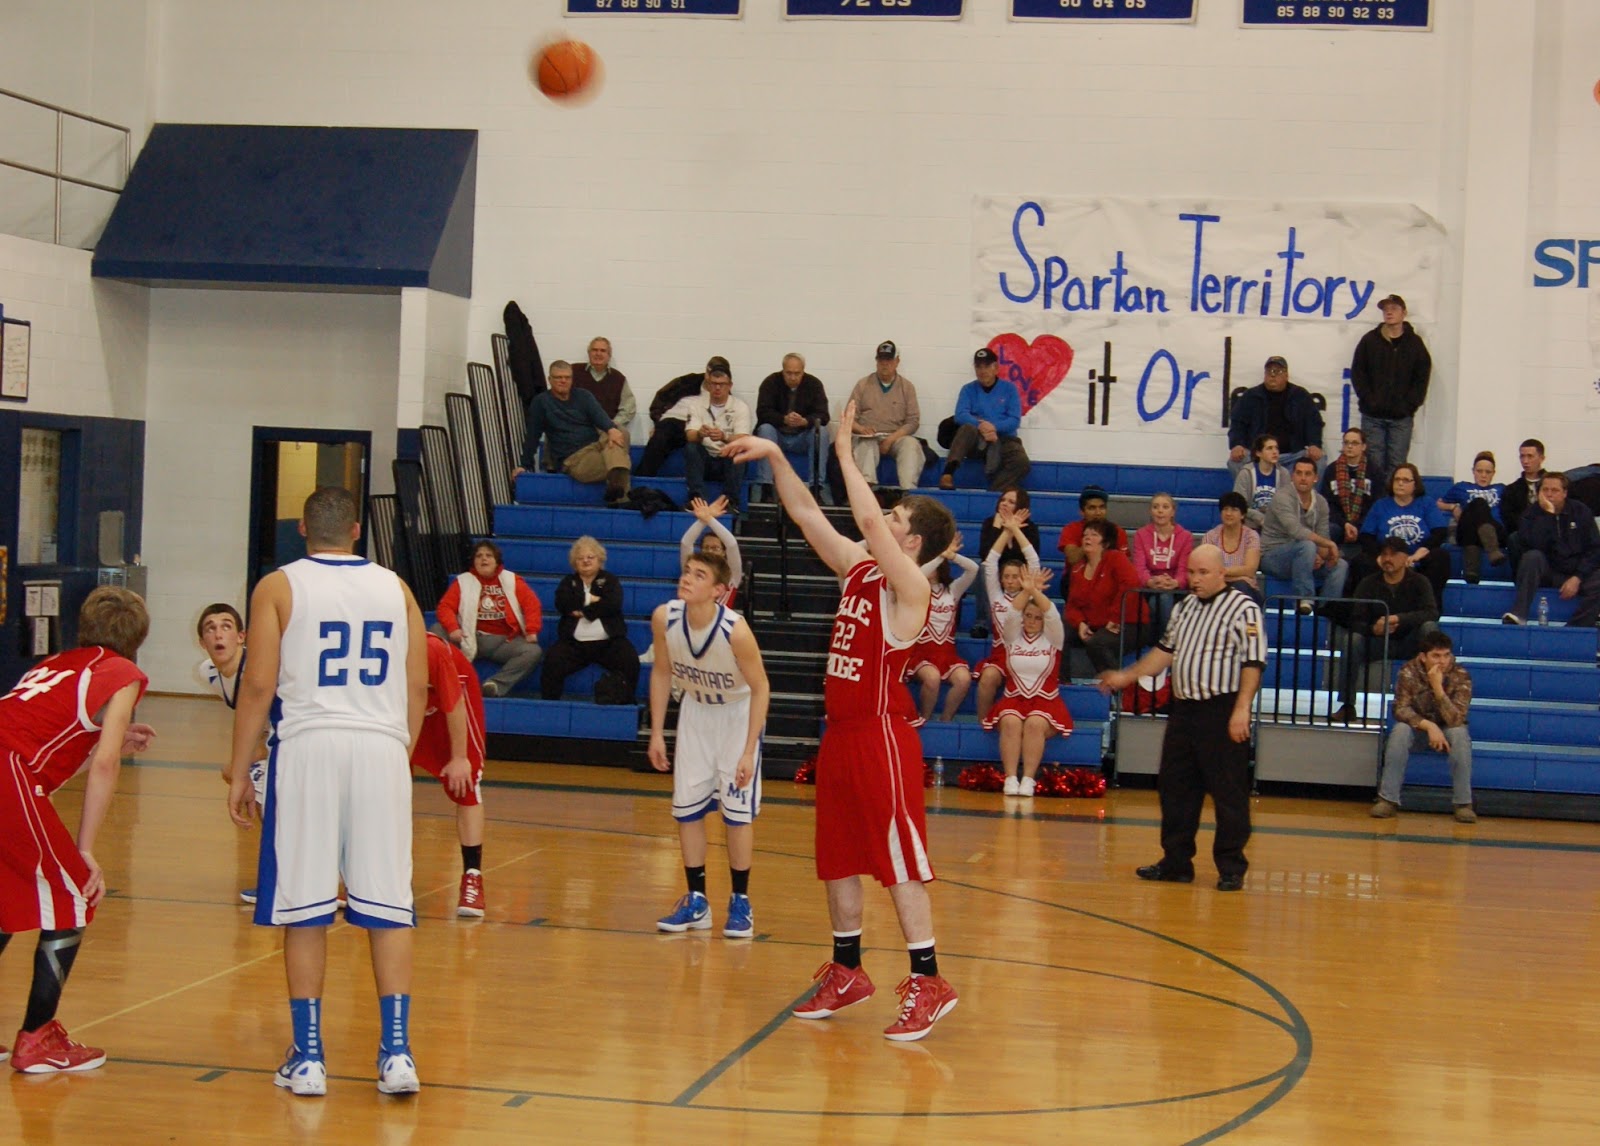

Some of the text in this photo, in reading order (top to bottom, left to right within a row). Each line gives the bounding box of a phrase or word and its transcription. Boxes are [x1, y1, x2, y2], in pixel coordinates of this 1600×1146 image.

[1277, 6, 1395, 19] 85 88 90 92 93
[1179, 213, 1375, 320] Territory
[1088, 341, 1118, 426] it
[1137, 348, 1210, 422] Or
[317, 620, 394, 687] 25
[831, 620, 857, 651] 22
[671, 661, 735, 690] SPARTANS
